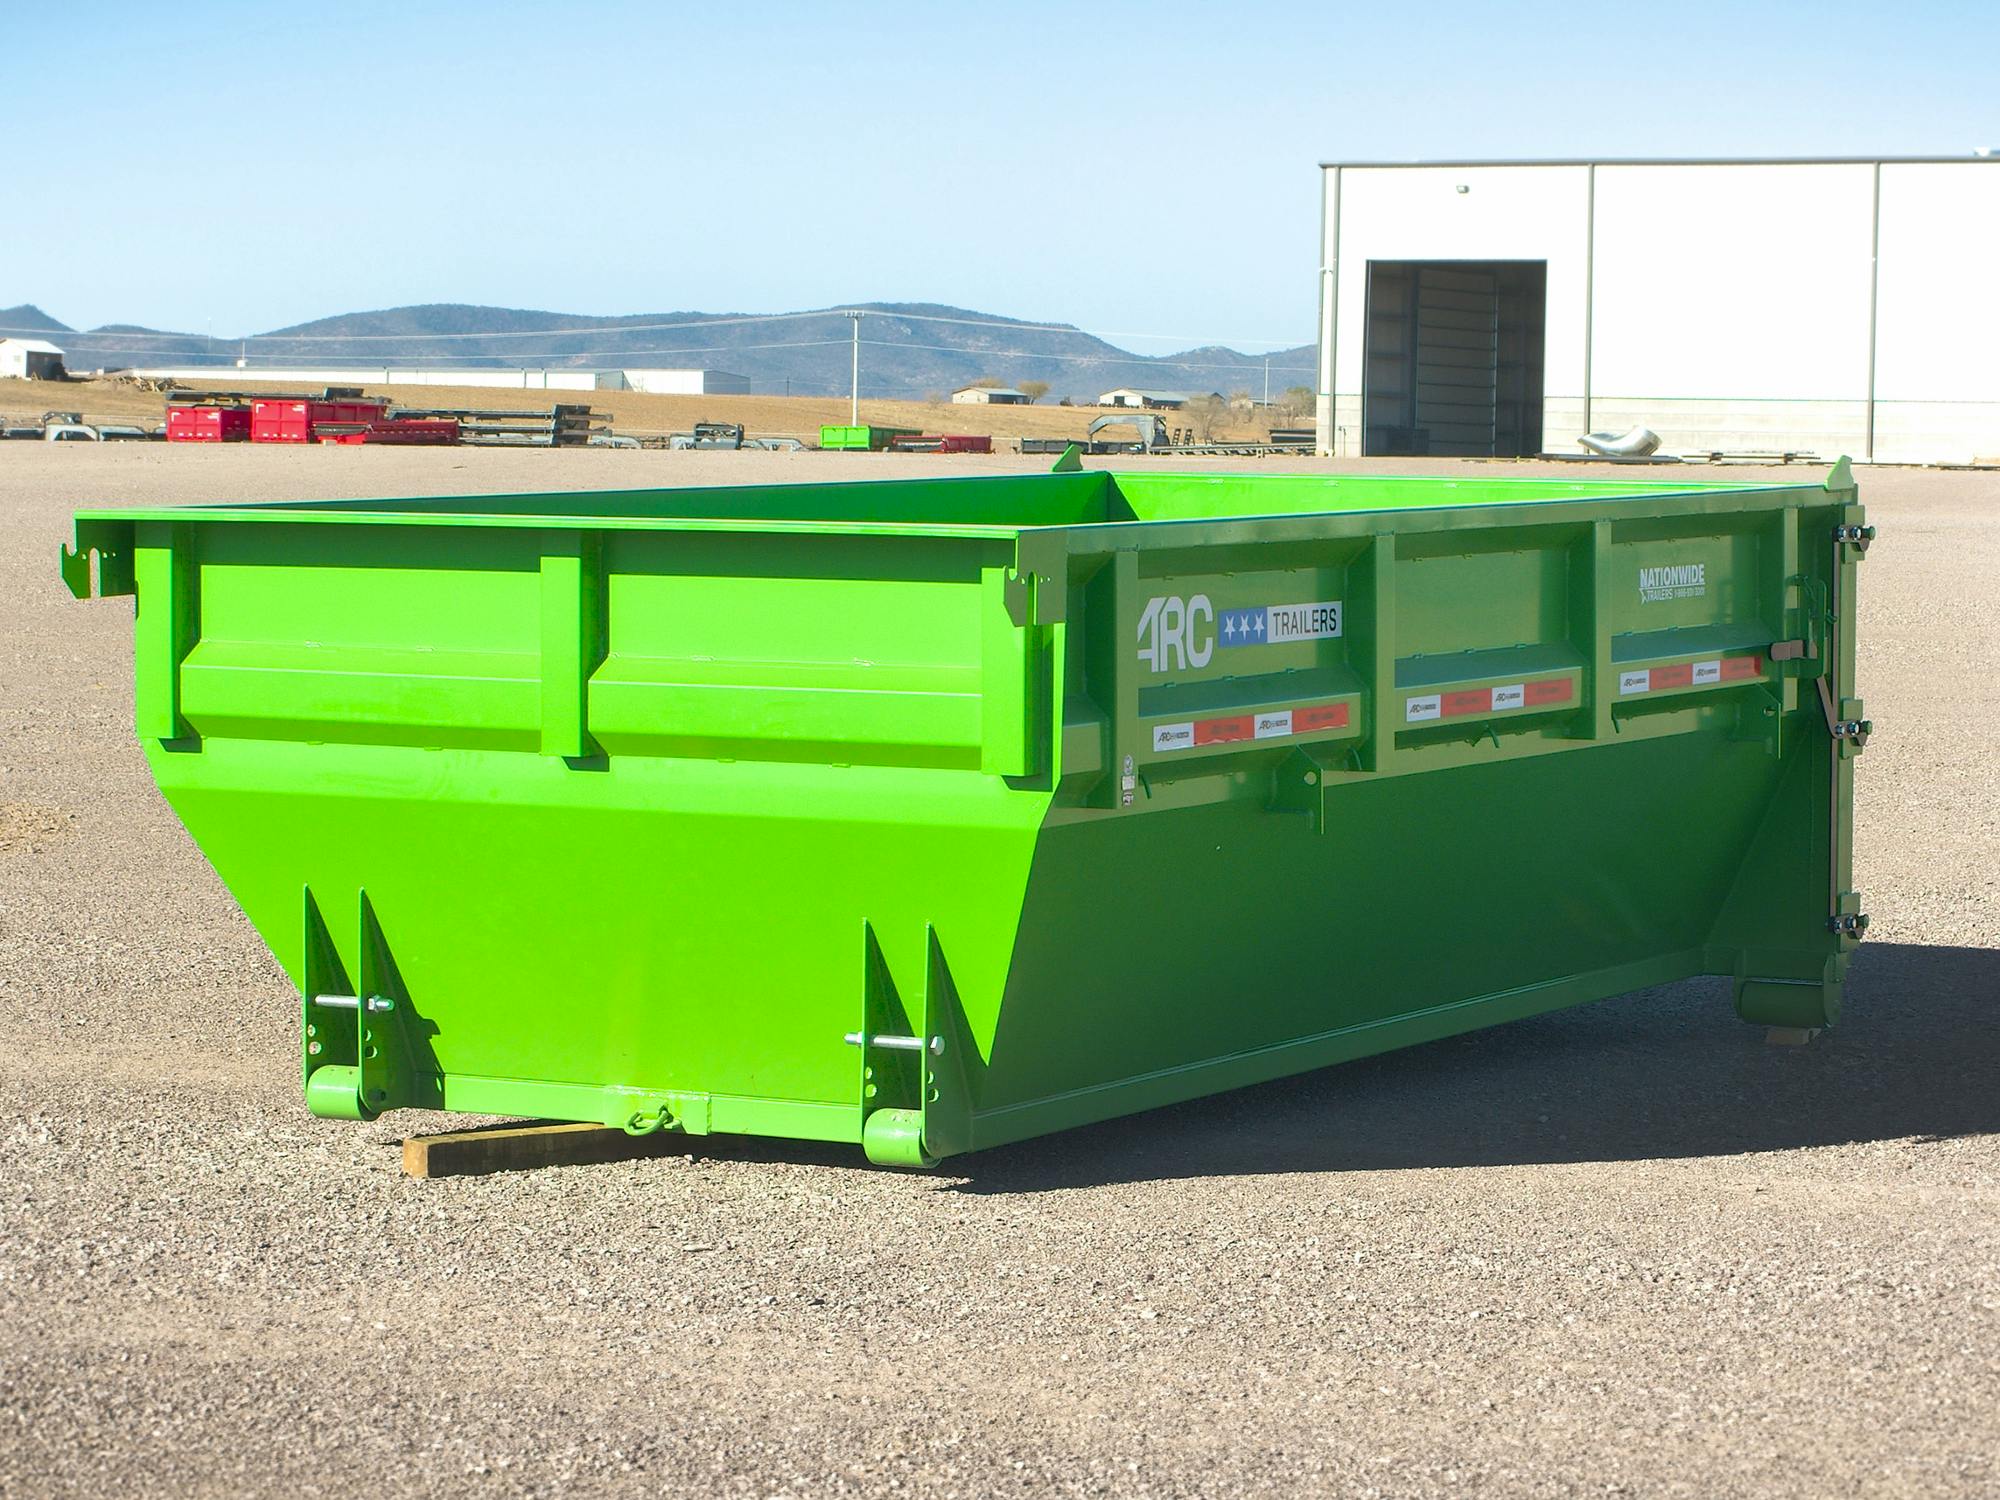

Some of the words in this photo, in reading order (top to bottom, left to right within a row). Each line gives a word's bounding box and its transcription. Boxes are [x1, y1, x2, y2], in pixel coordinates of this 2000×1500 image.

[1640, 564, 1705, 587] NATIONWIDE
[1137, 594, 1213, 673] ARC
[1273, 608, 1337, 637] TRAILERS
